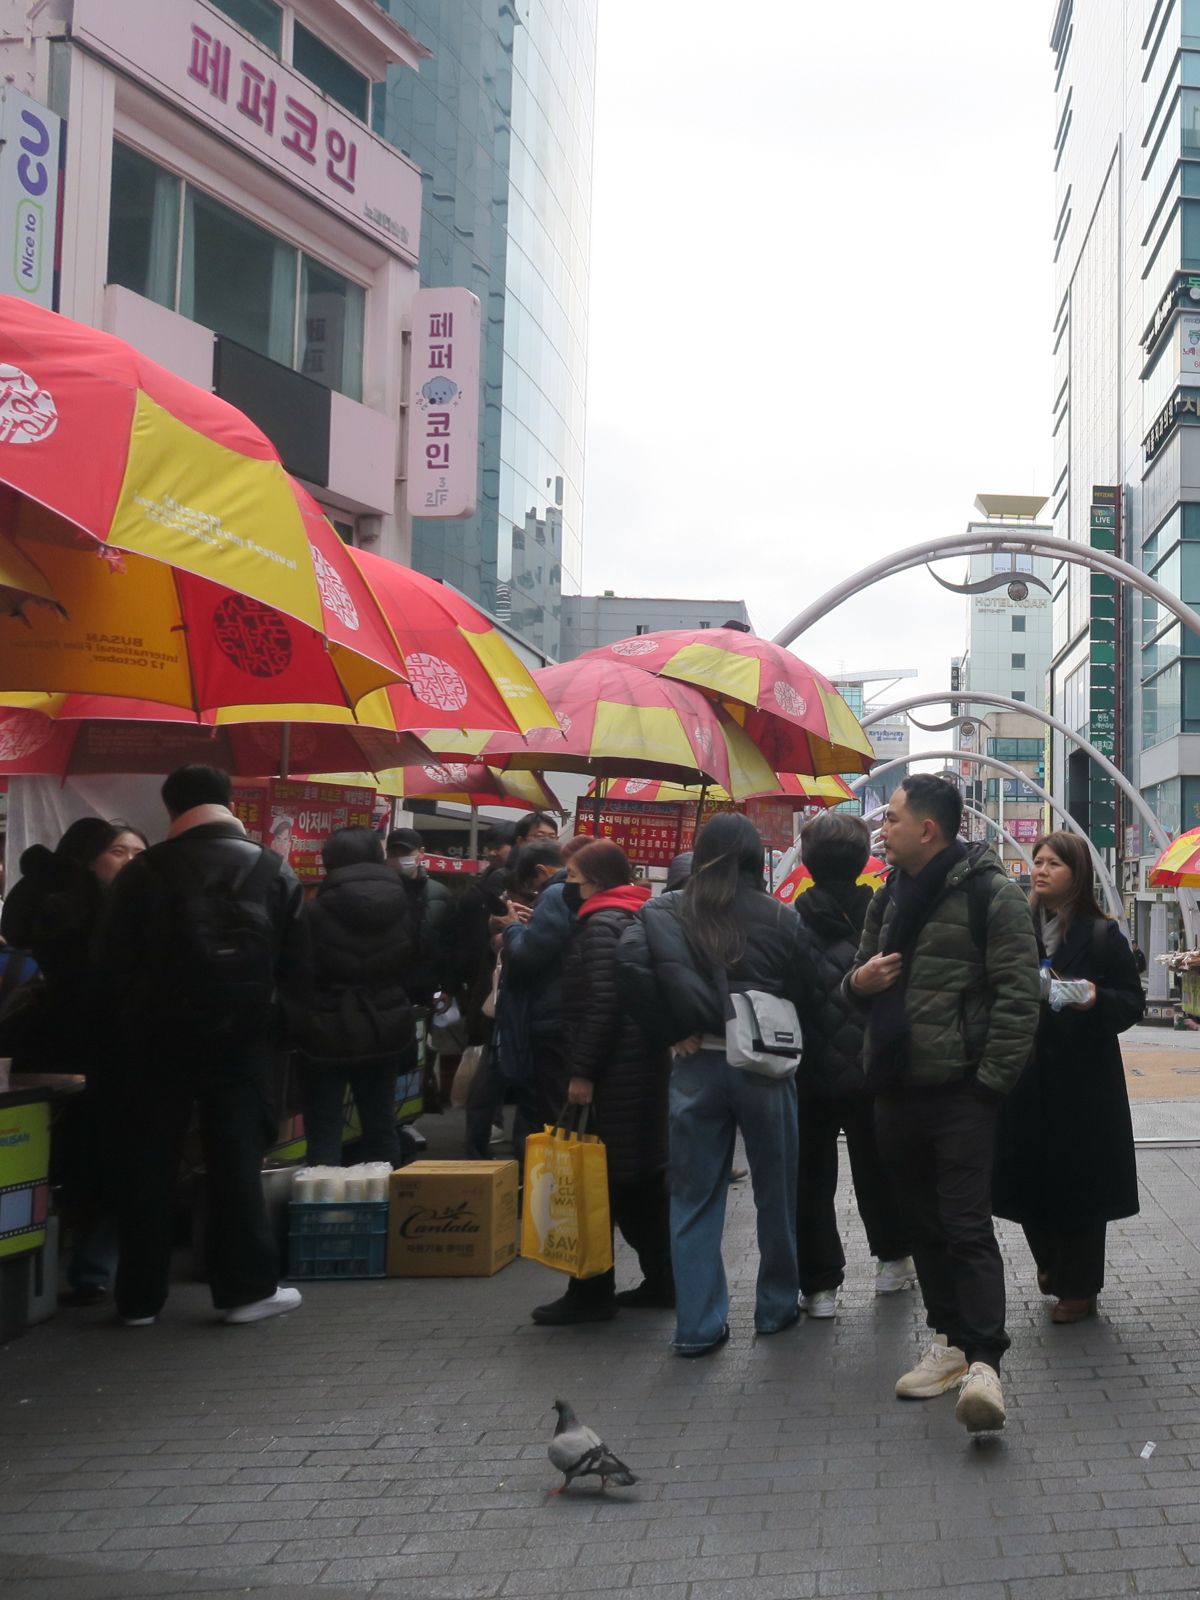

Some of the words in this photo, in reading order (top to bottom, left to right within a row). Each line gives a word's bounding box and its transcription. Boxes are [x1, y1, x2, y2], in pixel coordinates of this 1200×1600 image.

[187, 22, 357, 194] 페퍼코인
[18, 110, 49, 196] CU
[25, 213, 36, 231] to
[22, 236, 36, 278] Nice
[1095, 516, 1111, 524] LIVE
[975, 597, 1013, 608] HOTEL
